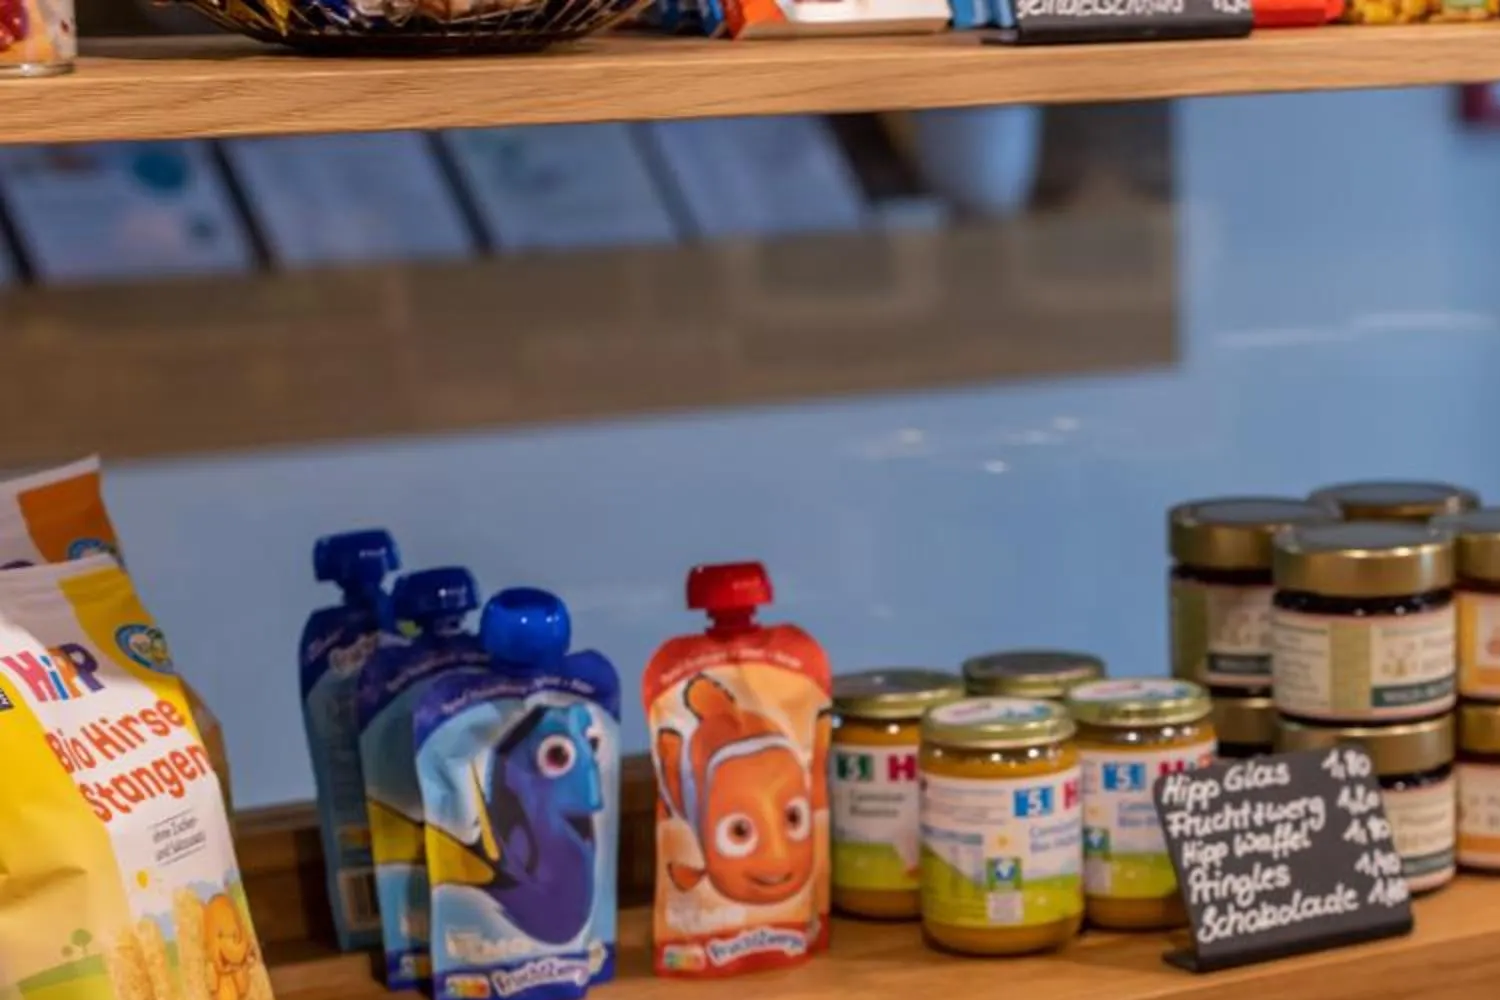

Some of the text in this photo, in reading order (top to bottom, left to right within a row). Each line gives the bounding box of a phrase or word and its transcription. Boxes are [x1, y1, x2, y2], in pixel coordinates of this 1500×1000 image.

[2, 643, 105, 702] HiPP
[44, 699, 187, 774] Bio Hirse
[79, 744, 209, 823] Stangen
[1162, 774, 1221, 811] Hipp
[1223, 760, 1291, 792] Glas
[1188, 862, 1292, 907] Pringles
